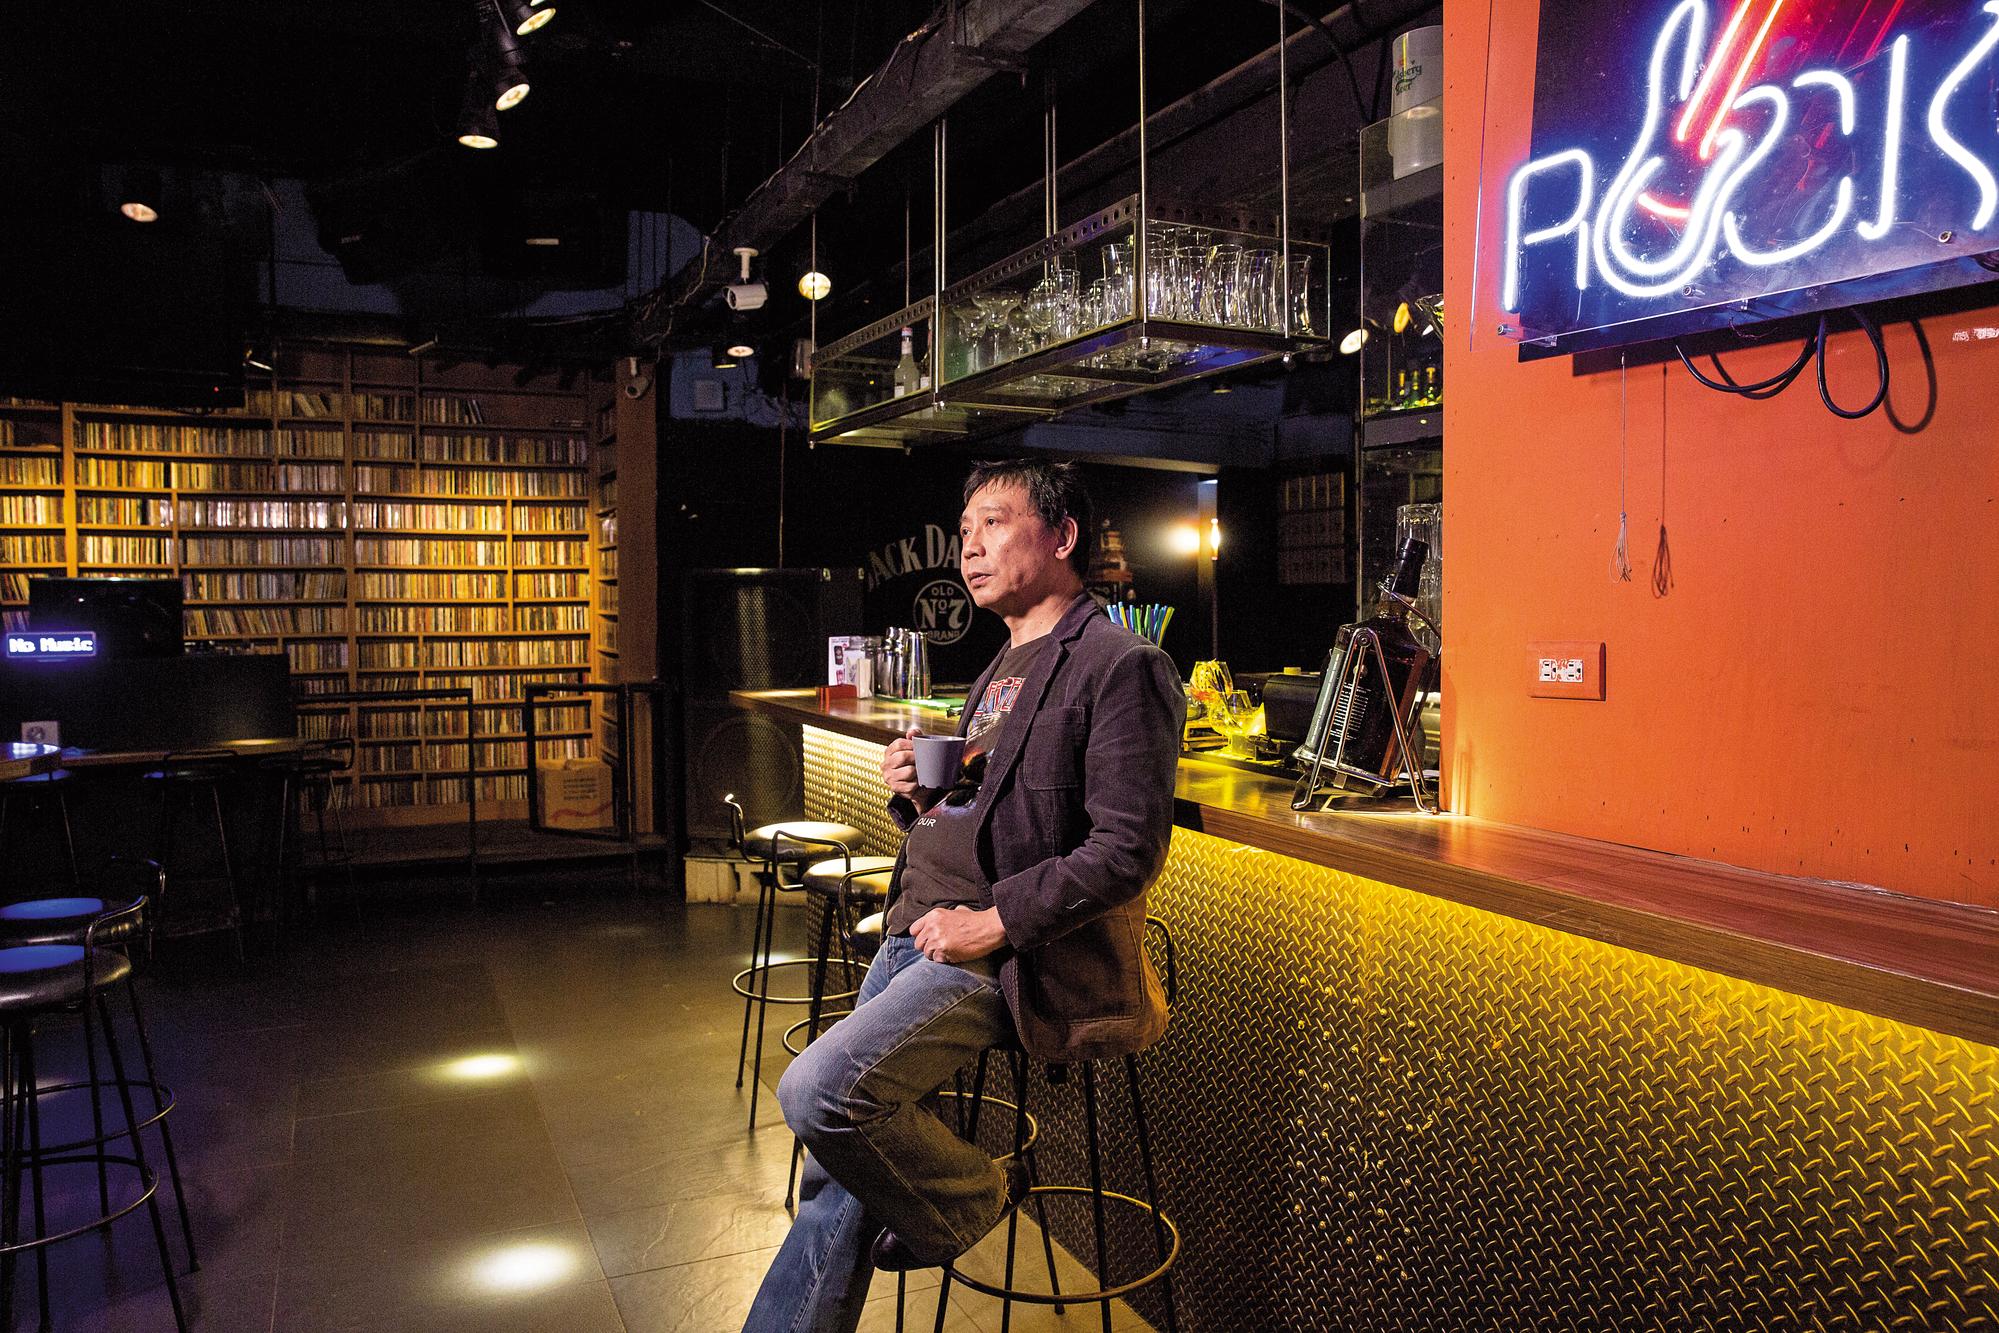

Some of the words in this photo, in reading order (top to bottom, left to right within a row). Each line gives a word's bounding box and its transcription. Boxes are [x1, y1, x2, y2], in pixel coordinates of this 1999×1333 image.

[925, 523, 961, 569] DA
[931, 586, 954, 596] OLD
[9, 638, 36, 653] No
[40, 637, 93, 652] Music
[917, 817, 937, 828] OUR
